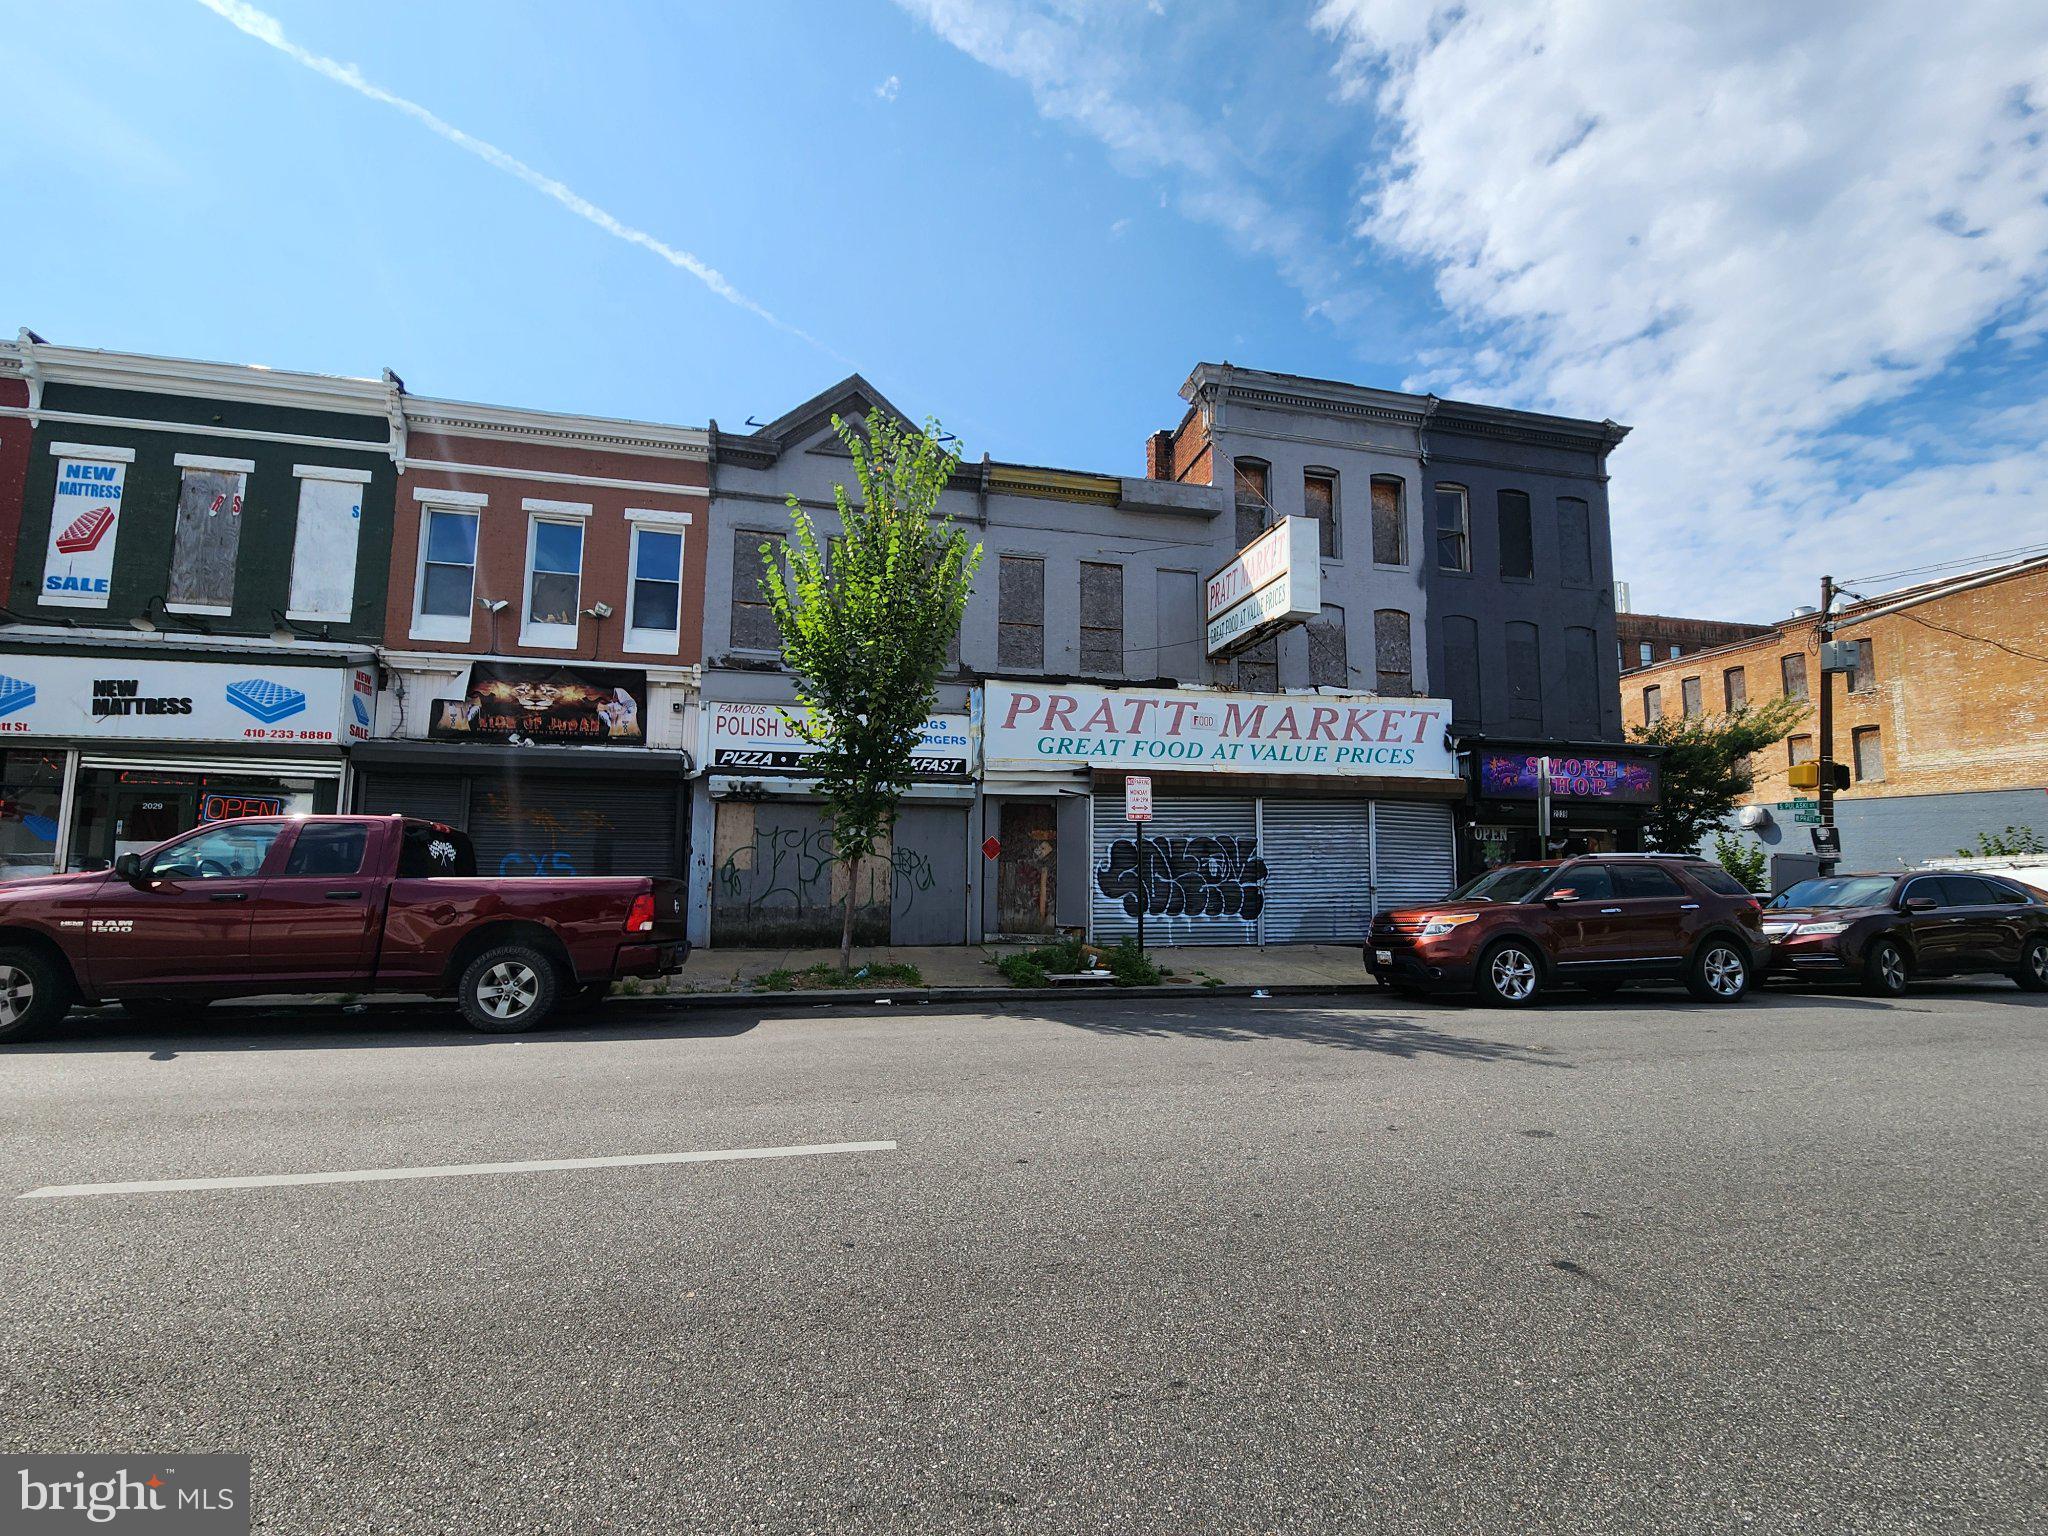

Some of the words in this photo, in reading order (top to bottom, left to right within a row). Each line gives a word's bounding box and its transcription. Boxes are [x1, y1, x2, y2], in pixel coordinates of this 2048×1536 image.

[66, 464, 116, 482] NEW
[58, 481, 121, 499] MATTRESS
[352, 505, 360, 518] S
[1209, 567, 1240, 612] PRATT
[1240, 532, 1287, 591] MARKET
[46, 576, 109, 593] SALE
[357, 669, 372, 685] NEW
[92, 679, 139, 697] NEW
[92, 697, 193, 716] MATTRESS
[717, 703, 767, 715] FAMOUS
[0, 722, 11, 731] tt
[14, 722, 31, 731] St.
[716, 716, 778, 737] POLISH
[915, 720, 947, 730] OGS
[1000, 692, 1199, 736] PRATT
[1218, 703, 1440, 744] MARKET
[1193, 716, 1214, 727] FOOD
[244, 728, 333, 740] 410-233-8880
[349, 723, 369, 740] SALE
[719, 751, 773, 766] PIZZA
[1037, 736, 1125, 756] GREAT
[1131, 740, 1204, 759] FOOD
[1211, 743, 1243, 760] AT
[1250, 744, 1328, 763] VALUE
[1334, 747, 1415, 765] PRICES
[902, 758, 962, 772] KFAST
[1525, 756, 1618, 777] SMOKE
[1548, 777, 1607, 795] HOP
[142, 802, 163, 810] 2029
[207, 797, 278, 819] OPEN
[1474, 827, 1508, 841] OPEN
